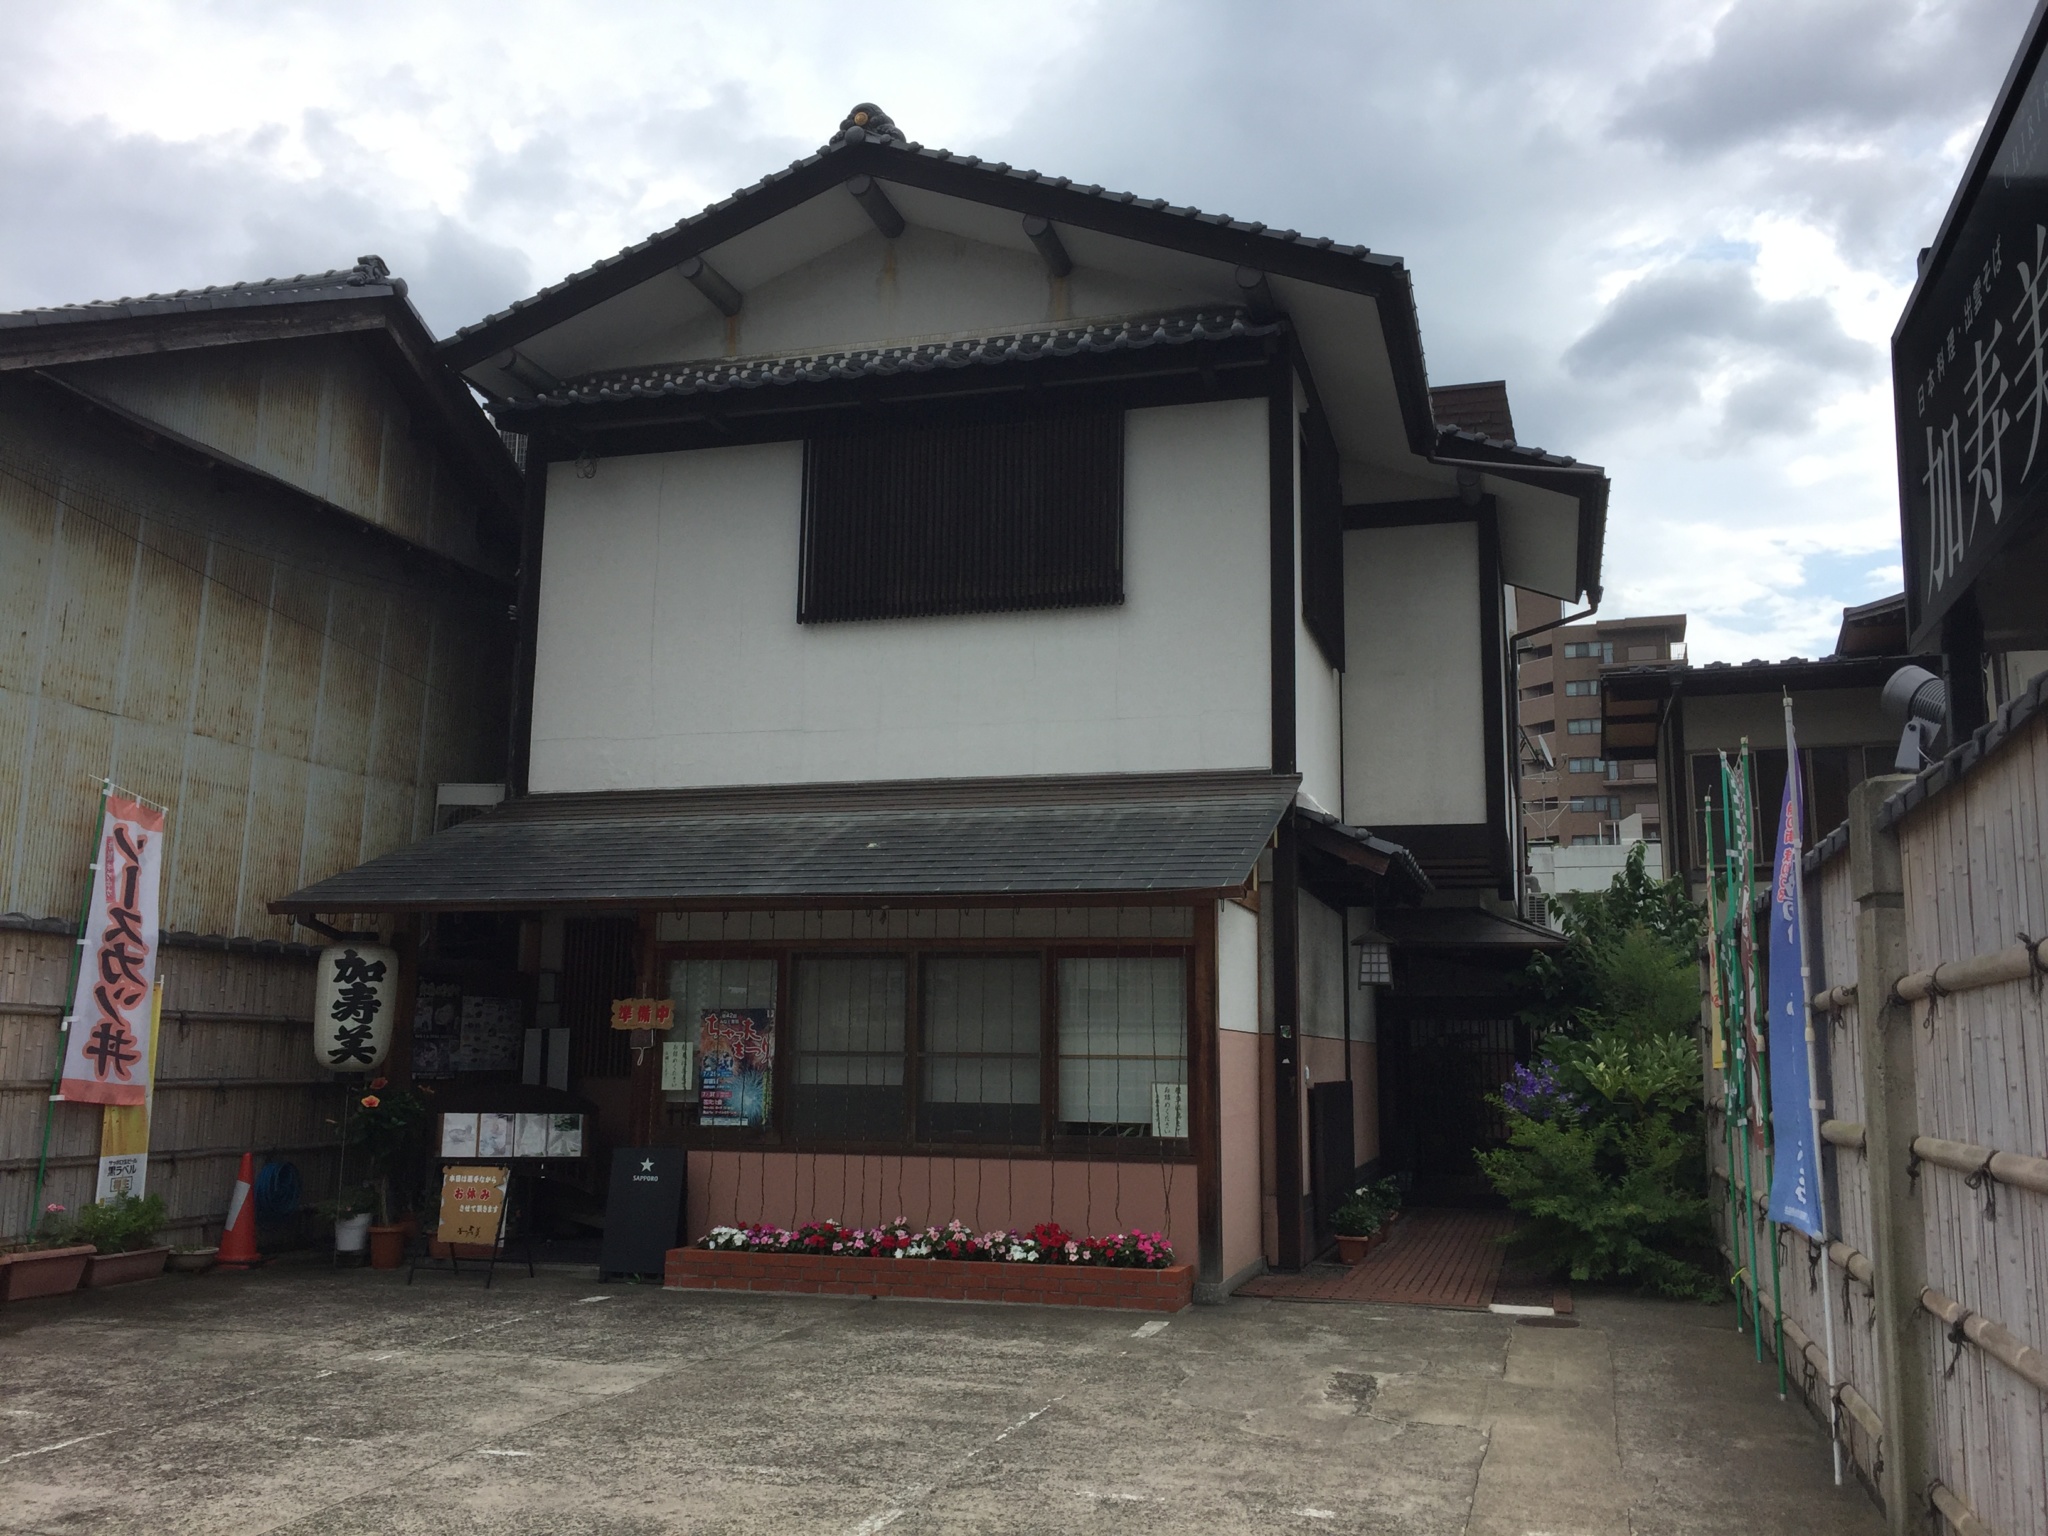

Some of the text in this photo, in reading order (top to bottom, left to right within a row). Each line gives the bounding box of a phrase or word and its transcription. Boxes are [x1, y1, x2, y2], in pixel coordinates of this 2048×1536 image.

[1917, 234, 2002, 418] 日本料理・出雲そば
[327, 949, 387, 1065] 加寿美
[619, 1004, 671, 1024] 準備中
[705, 1013, 761, 1041] ちゃった
[732, 1036, 769, 1064] まつり
[107, 1165, 137, 1176] 黒ラベル
[454, 1188, 491, 1200] お休み
